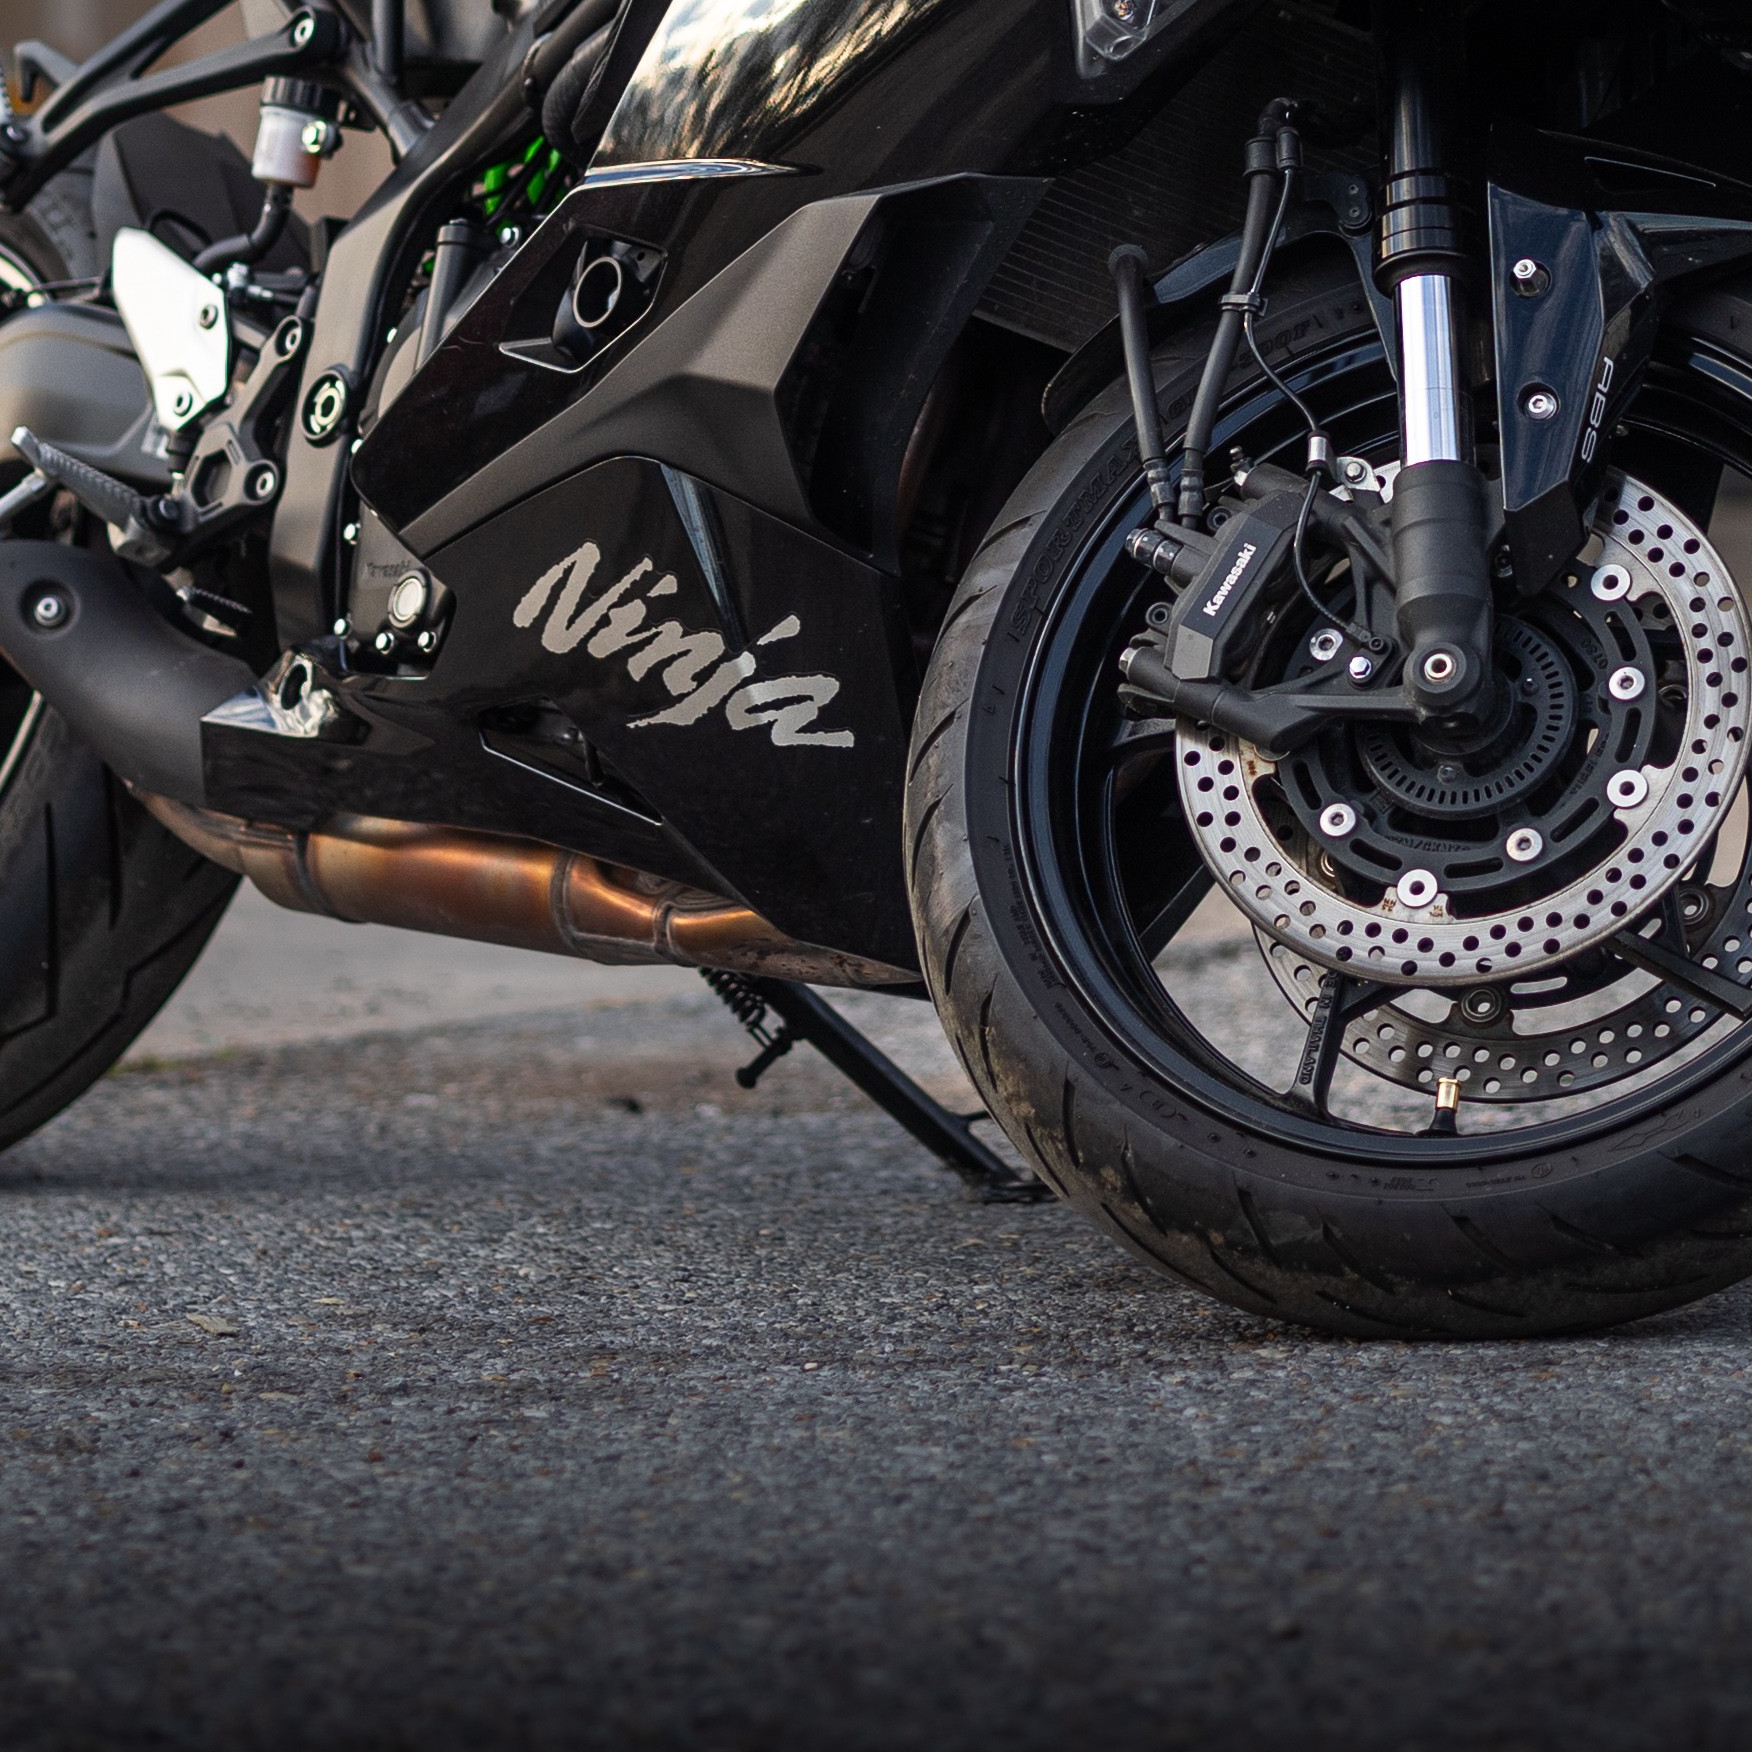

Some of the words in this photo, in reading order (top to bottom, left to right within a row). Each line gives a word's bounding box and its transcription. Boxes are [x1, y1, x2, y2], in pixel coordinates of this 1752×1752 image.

[1581, 356, 1614, 464] ABS
[1202, 543, 1256, 617] Kawasaki
[512, 540, 855, 749] Ninja
[1299, 1015, 1326, 1085] THAILAND
